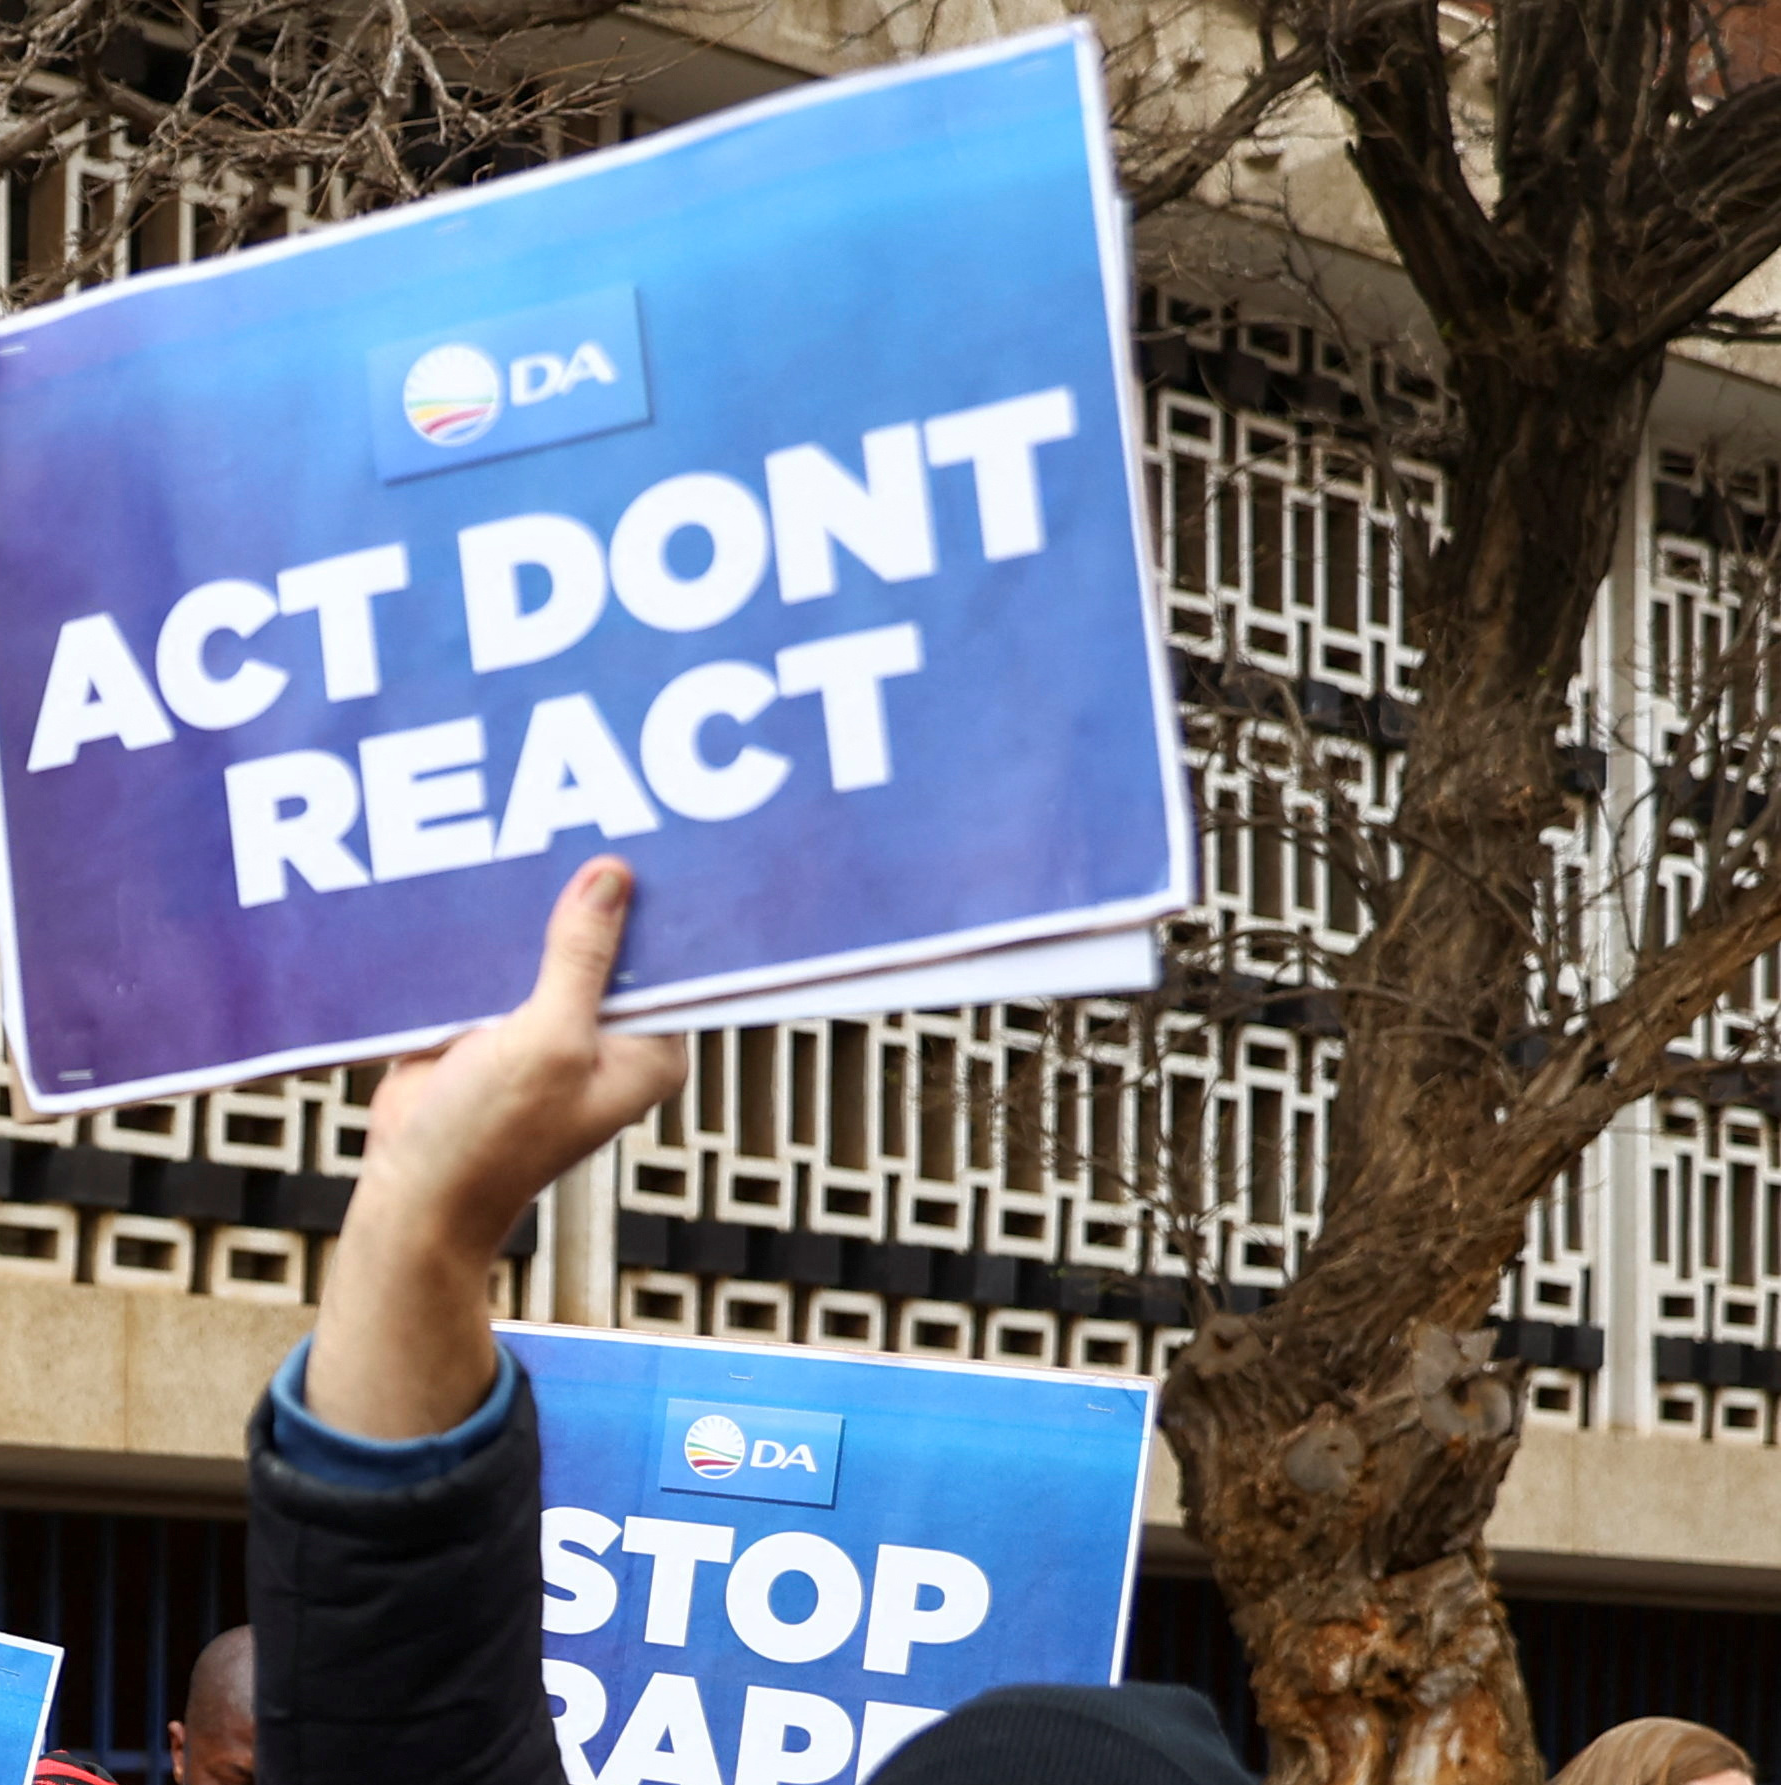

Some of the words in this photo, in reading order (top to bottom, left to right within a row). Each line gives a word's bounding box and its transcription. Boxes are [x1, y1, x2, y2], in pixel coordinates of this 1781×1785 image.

[509, 340, 617, 406] DA
[26, 541, 409, 772] ACT
[456, 385, 1077, 675] DONT
[224, 620, 923, 909] REACT
[749, 1439, 818, 1473] DA
[541, 1507, 991, 1675] STOP
